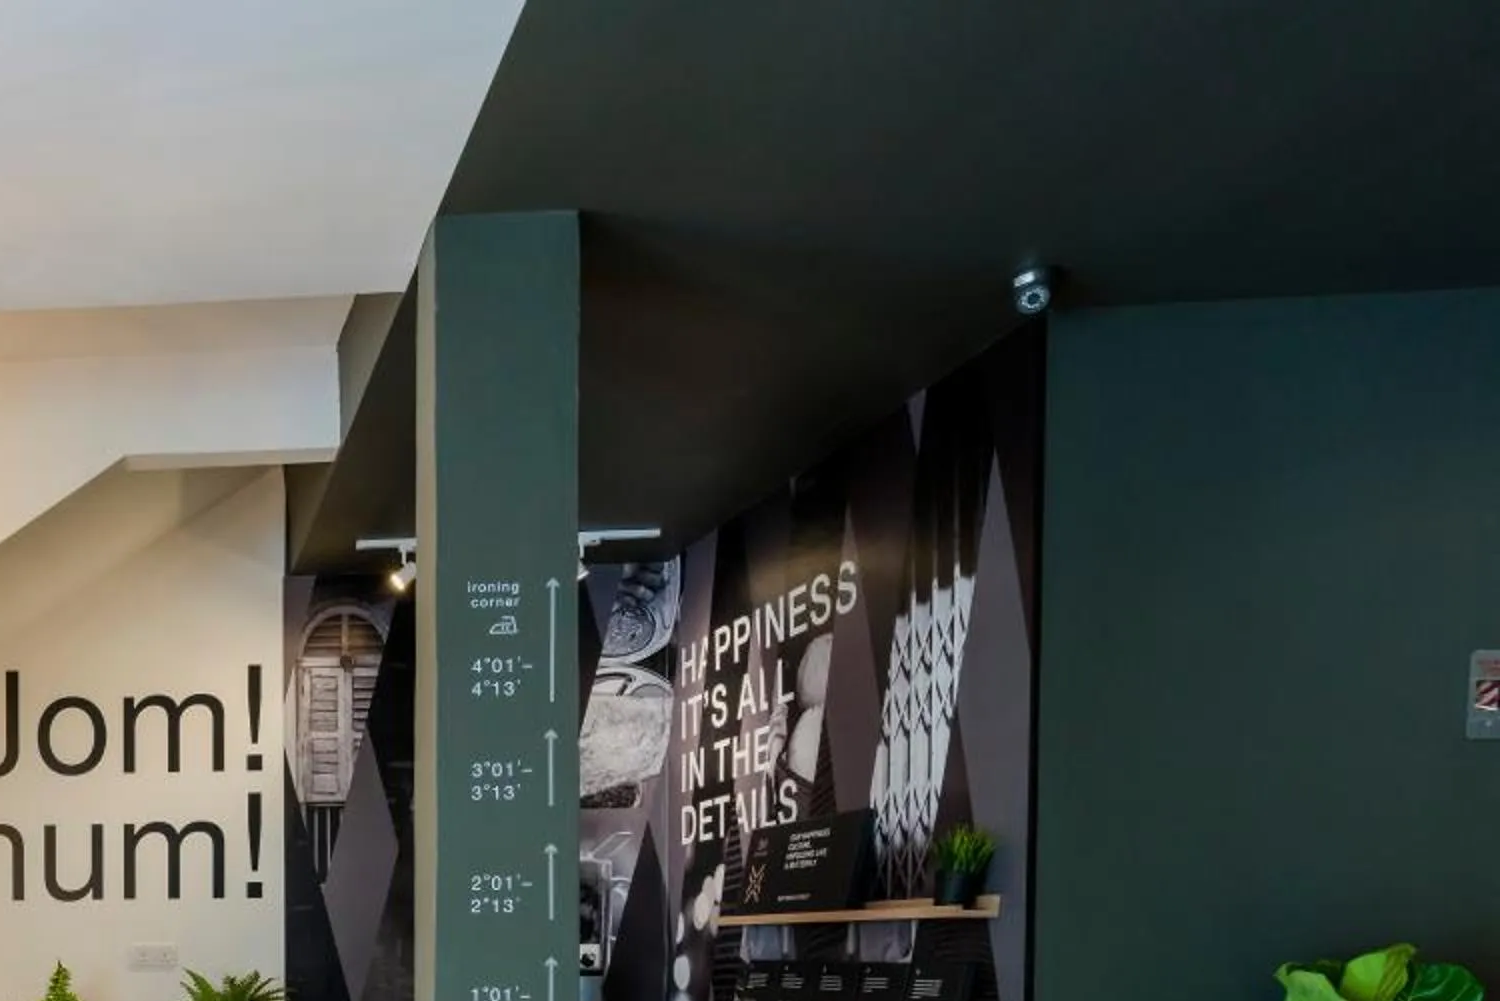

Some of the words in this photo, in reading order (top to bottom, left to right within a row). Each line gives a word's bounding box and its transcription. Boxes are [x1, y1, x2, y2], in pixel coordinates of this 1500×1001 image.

[467, 580, 520, 595] ironing
[470, 597, 521, 608] corner
[681, 683, 728, 741] IT'S
[736, 658, 795, 721] ALL
[681, 746, 705, 793] IN
[714, 725, 771, 783] THE
[681, 778, 799, 846] DETAILS
